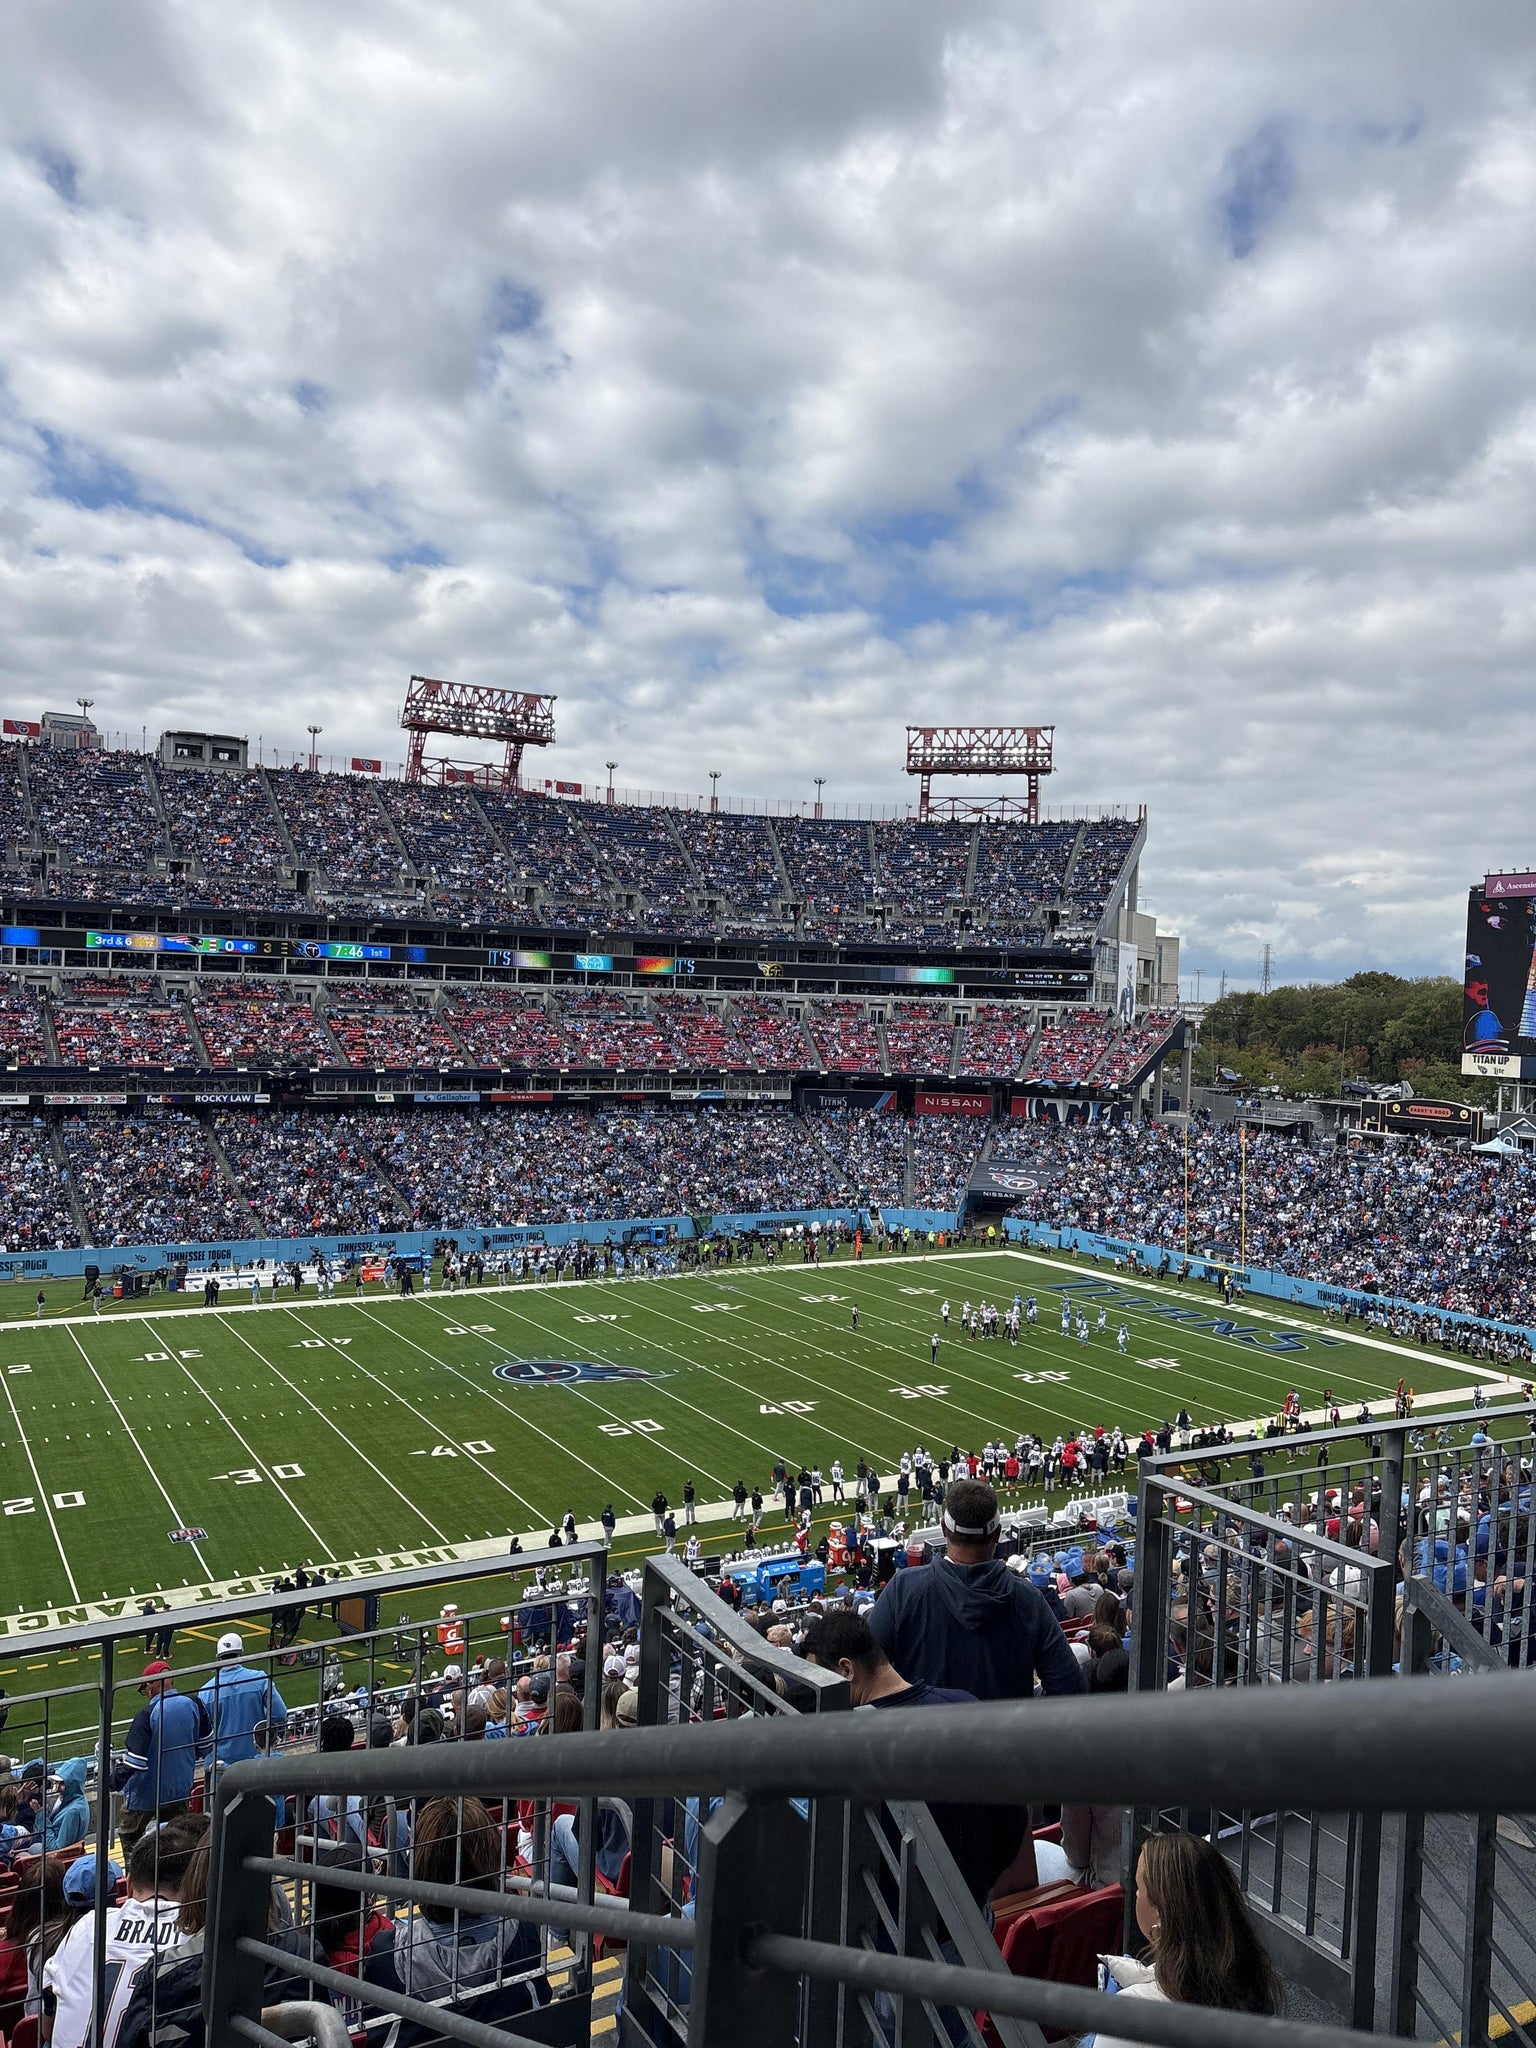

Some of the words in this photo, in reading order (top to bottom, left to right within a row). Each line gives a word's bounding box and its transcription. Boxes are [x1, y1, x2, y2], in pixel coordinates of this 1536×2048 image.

[95, 936, 112, 945] 3rd
[115, 937, 124, 945] &
[124, 938, 132, 946] 6
[224, 940, 235, 952] 0
[263, 942, 272, 954] 3
[335, 945, 363, 957] 7:46
[371, 949, 383, 957] 1st
[488, 950, 511, 966] IT'S
[674, 959, 695, 974] IT'S
[1472, 1054, 1497, 1065] TITAN
[1497, 1055, 1510, 1066] UP
[146, 1095, 172, 1104] FedEx
[195, 1094, 228, 1103] ROCKY
[230, 1094, 251, 1103] LAW
[436, 1092, 471, 1101] Gallagher
[925, 1097, 983, 1108] NISSAN
[988, 1167, 1050, 1175] NISSAN
[492, 1232, 523, 1244] TENNESSEE
[337, 1241, 373, 1253] TENNESSEE
[166, 1250, 205, 1262] TENNESSEE
[208, 1249, 232, 1261] TOUGH
[690, 1303, 741, 1313] 30
[572, 1314, 618, 1324] 40
[443, 1324, 497, 1336] 50
[300, 1337, 353, 1349] 40
[145, 1349, 203, 1362] 30
[1012, 1370, 1069, 1384] 20
[888, 1384, 947, 1399] 30
[759, 1400, 815, 1416] 40
[597, 1419, 665, 1437] 50
[430, 1440, 496, 1459] 40
[228, 1463, 306, 1485] 30
[3, 1491, 87, 1516] 20
[687, 1547, 696, 1556] 51
[447, 1629, 457, 1640] G
